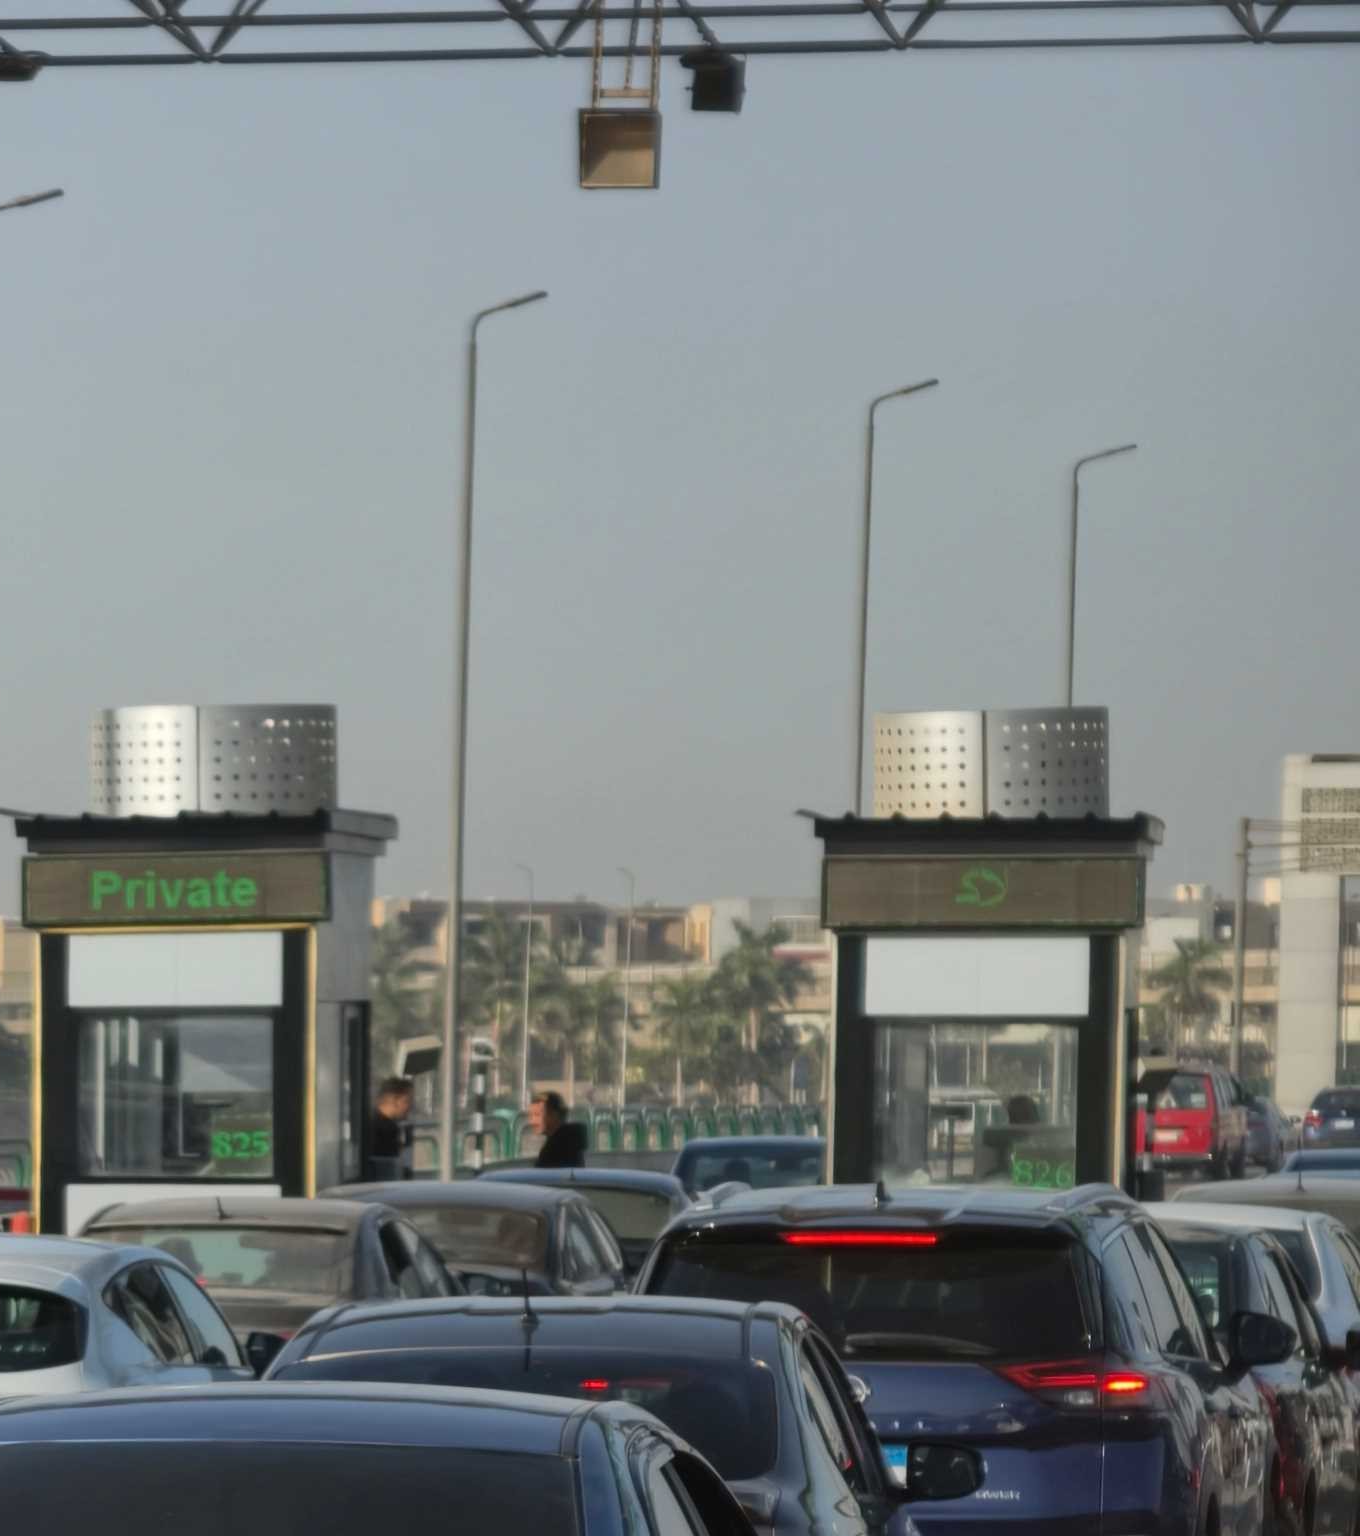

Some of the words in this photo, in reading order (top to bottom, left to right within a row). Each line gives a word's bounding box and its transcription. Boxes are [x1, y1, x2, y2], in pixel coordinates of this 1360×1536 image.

[92, 869, 258, 910] Private
[212, 1131, 269, 1157] 825
[1015, 1160, 1073, 1189] 826
